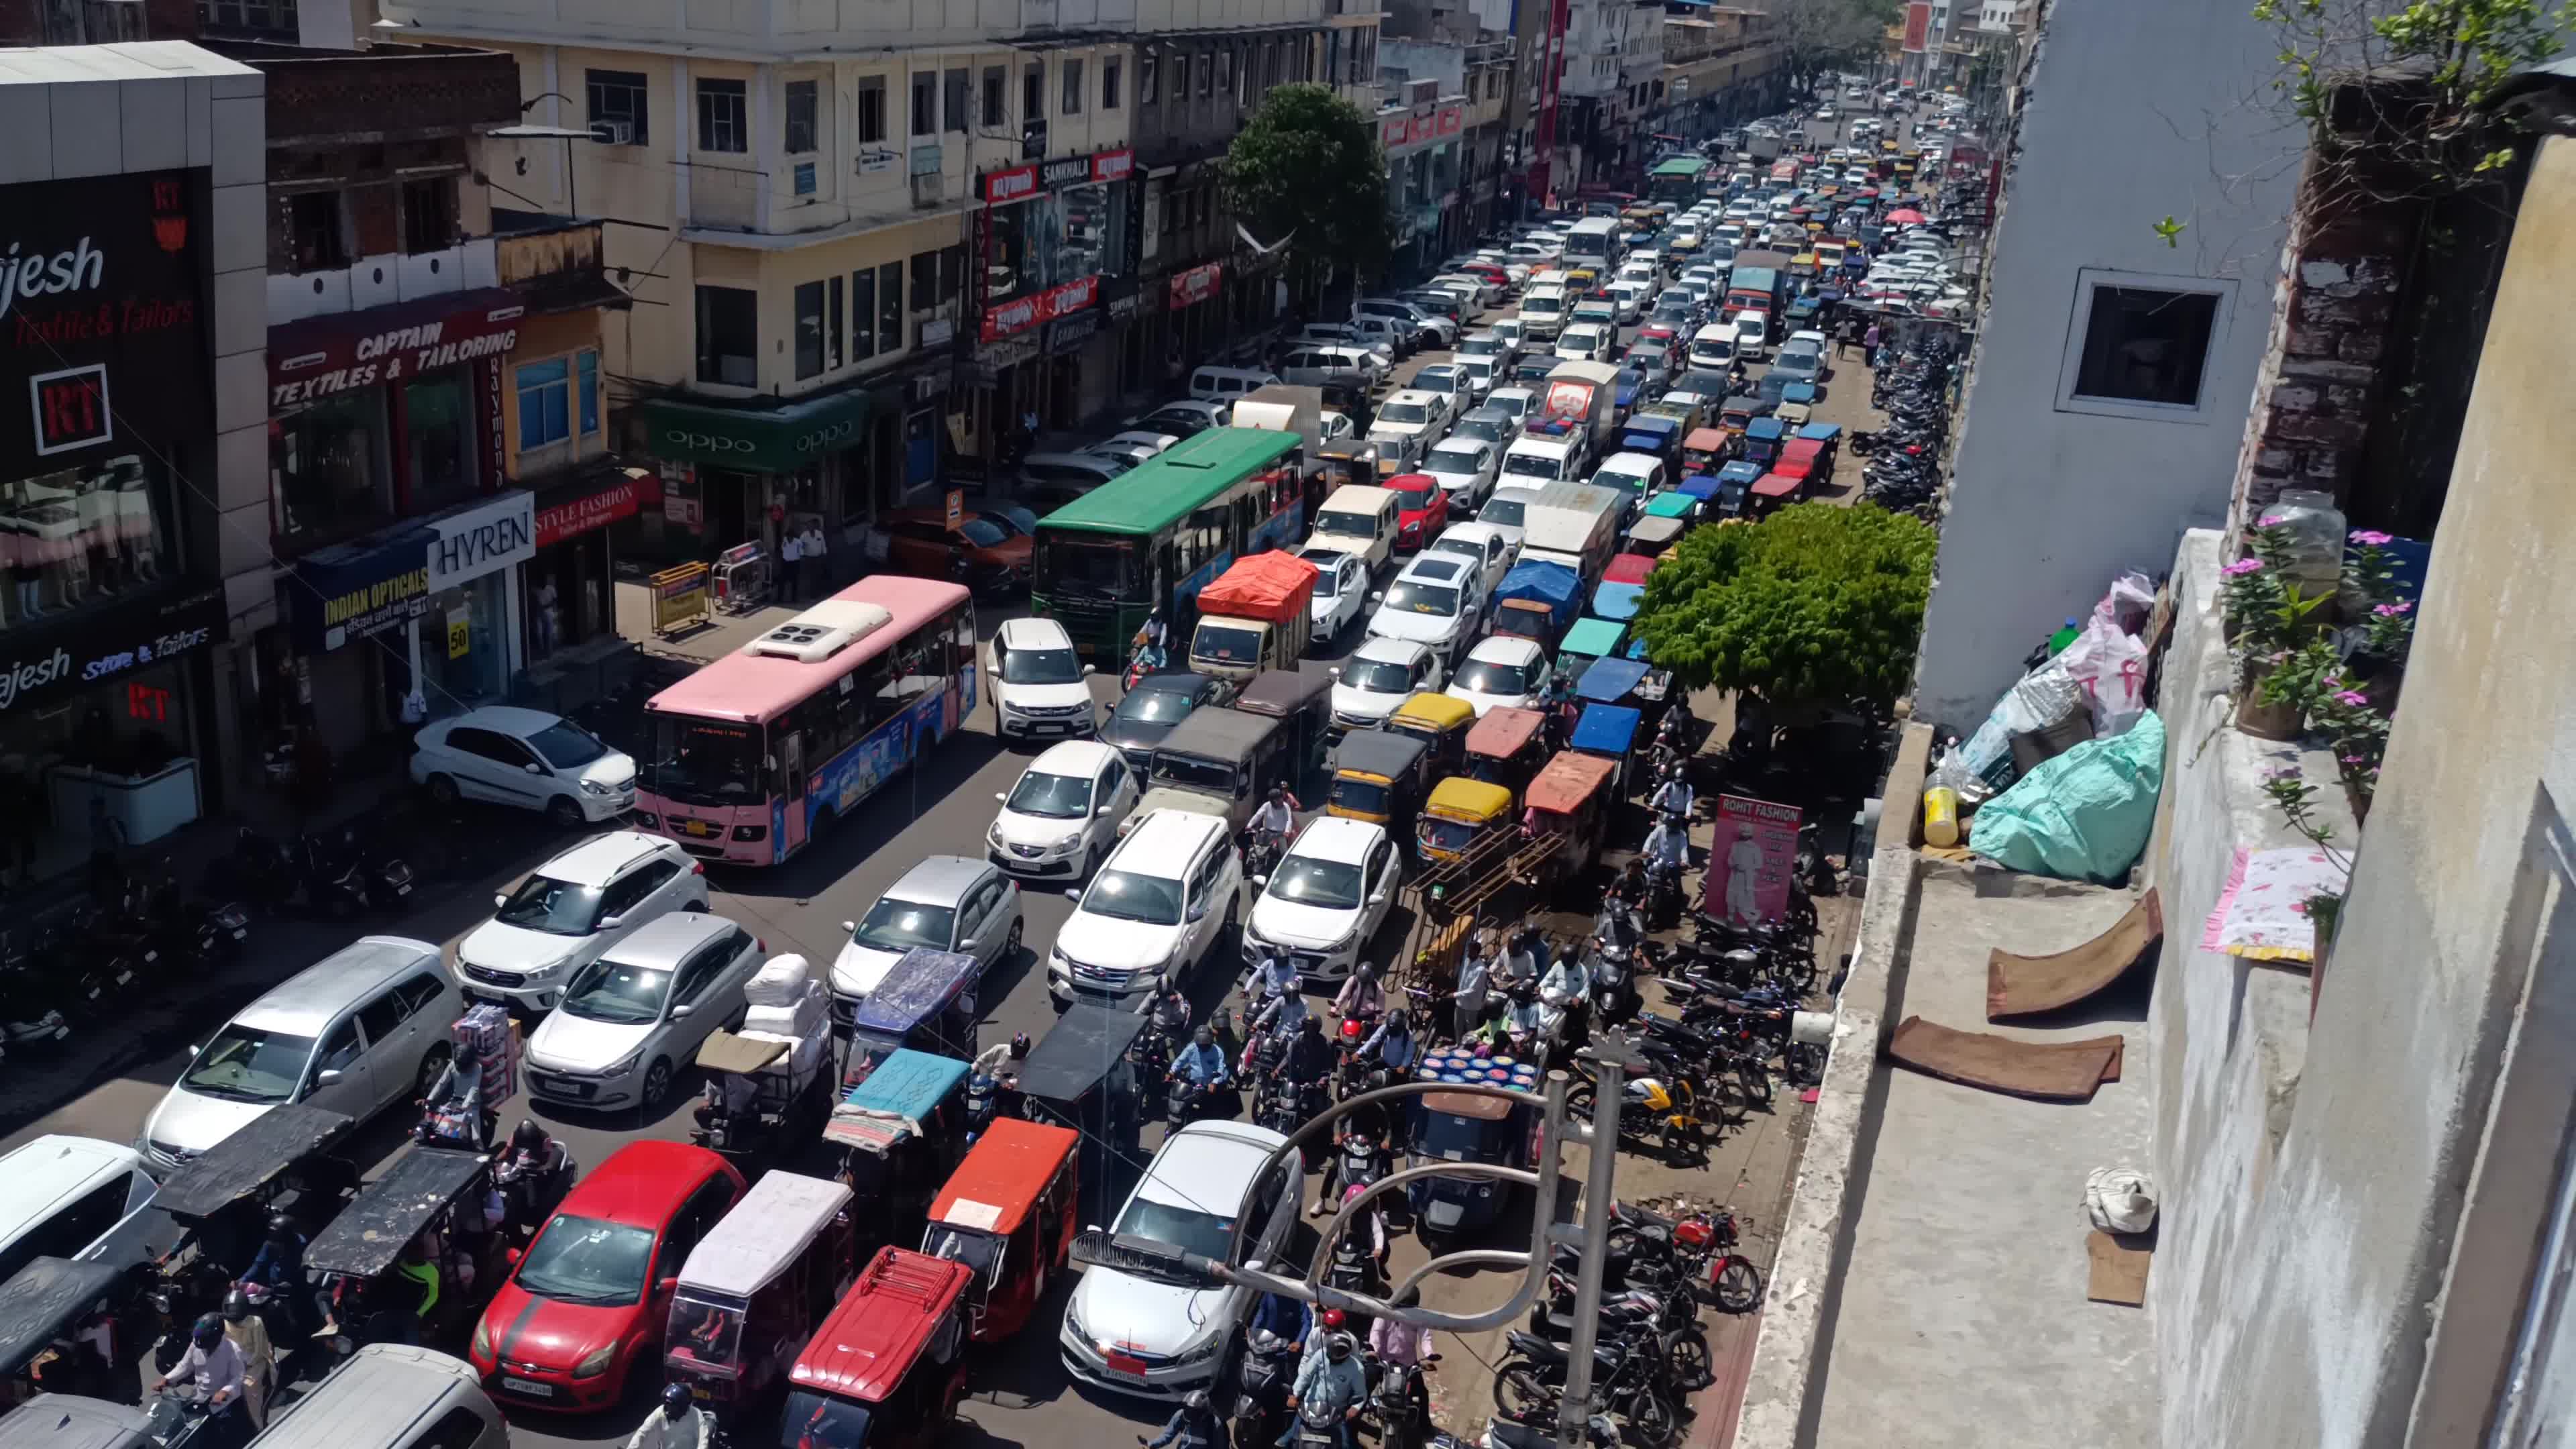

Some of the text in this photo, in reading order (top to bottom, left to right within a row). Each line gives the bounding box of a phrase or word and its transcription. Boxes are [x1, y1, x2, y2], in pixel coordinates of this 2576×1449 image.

[0, 236, 104, 319] jesh
[96, 302, 114, 338] &
[121, 297, 194, 335] Tailors
[356, 321, 444, 362] CAPTAIN
[273, 329, 517, 406] TEXTILES & TAILORING
[43, 381, 101, 439] RT
[535, 503, 576, 533] STYLE
[579, 485, 633, 517] FASHION
[437, 511, 531, 575] HYREN
[324, 588, 369, 627] INDIAN
[371, 567, 429, 609] OPTICALS
[155, 627, 209, 657] Tailors
[127, 681, 171, 724] RT
[1722, 798, 1752, 814] ROHIT
[1755, 803, 1799, 822] FASHION
